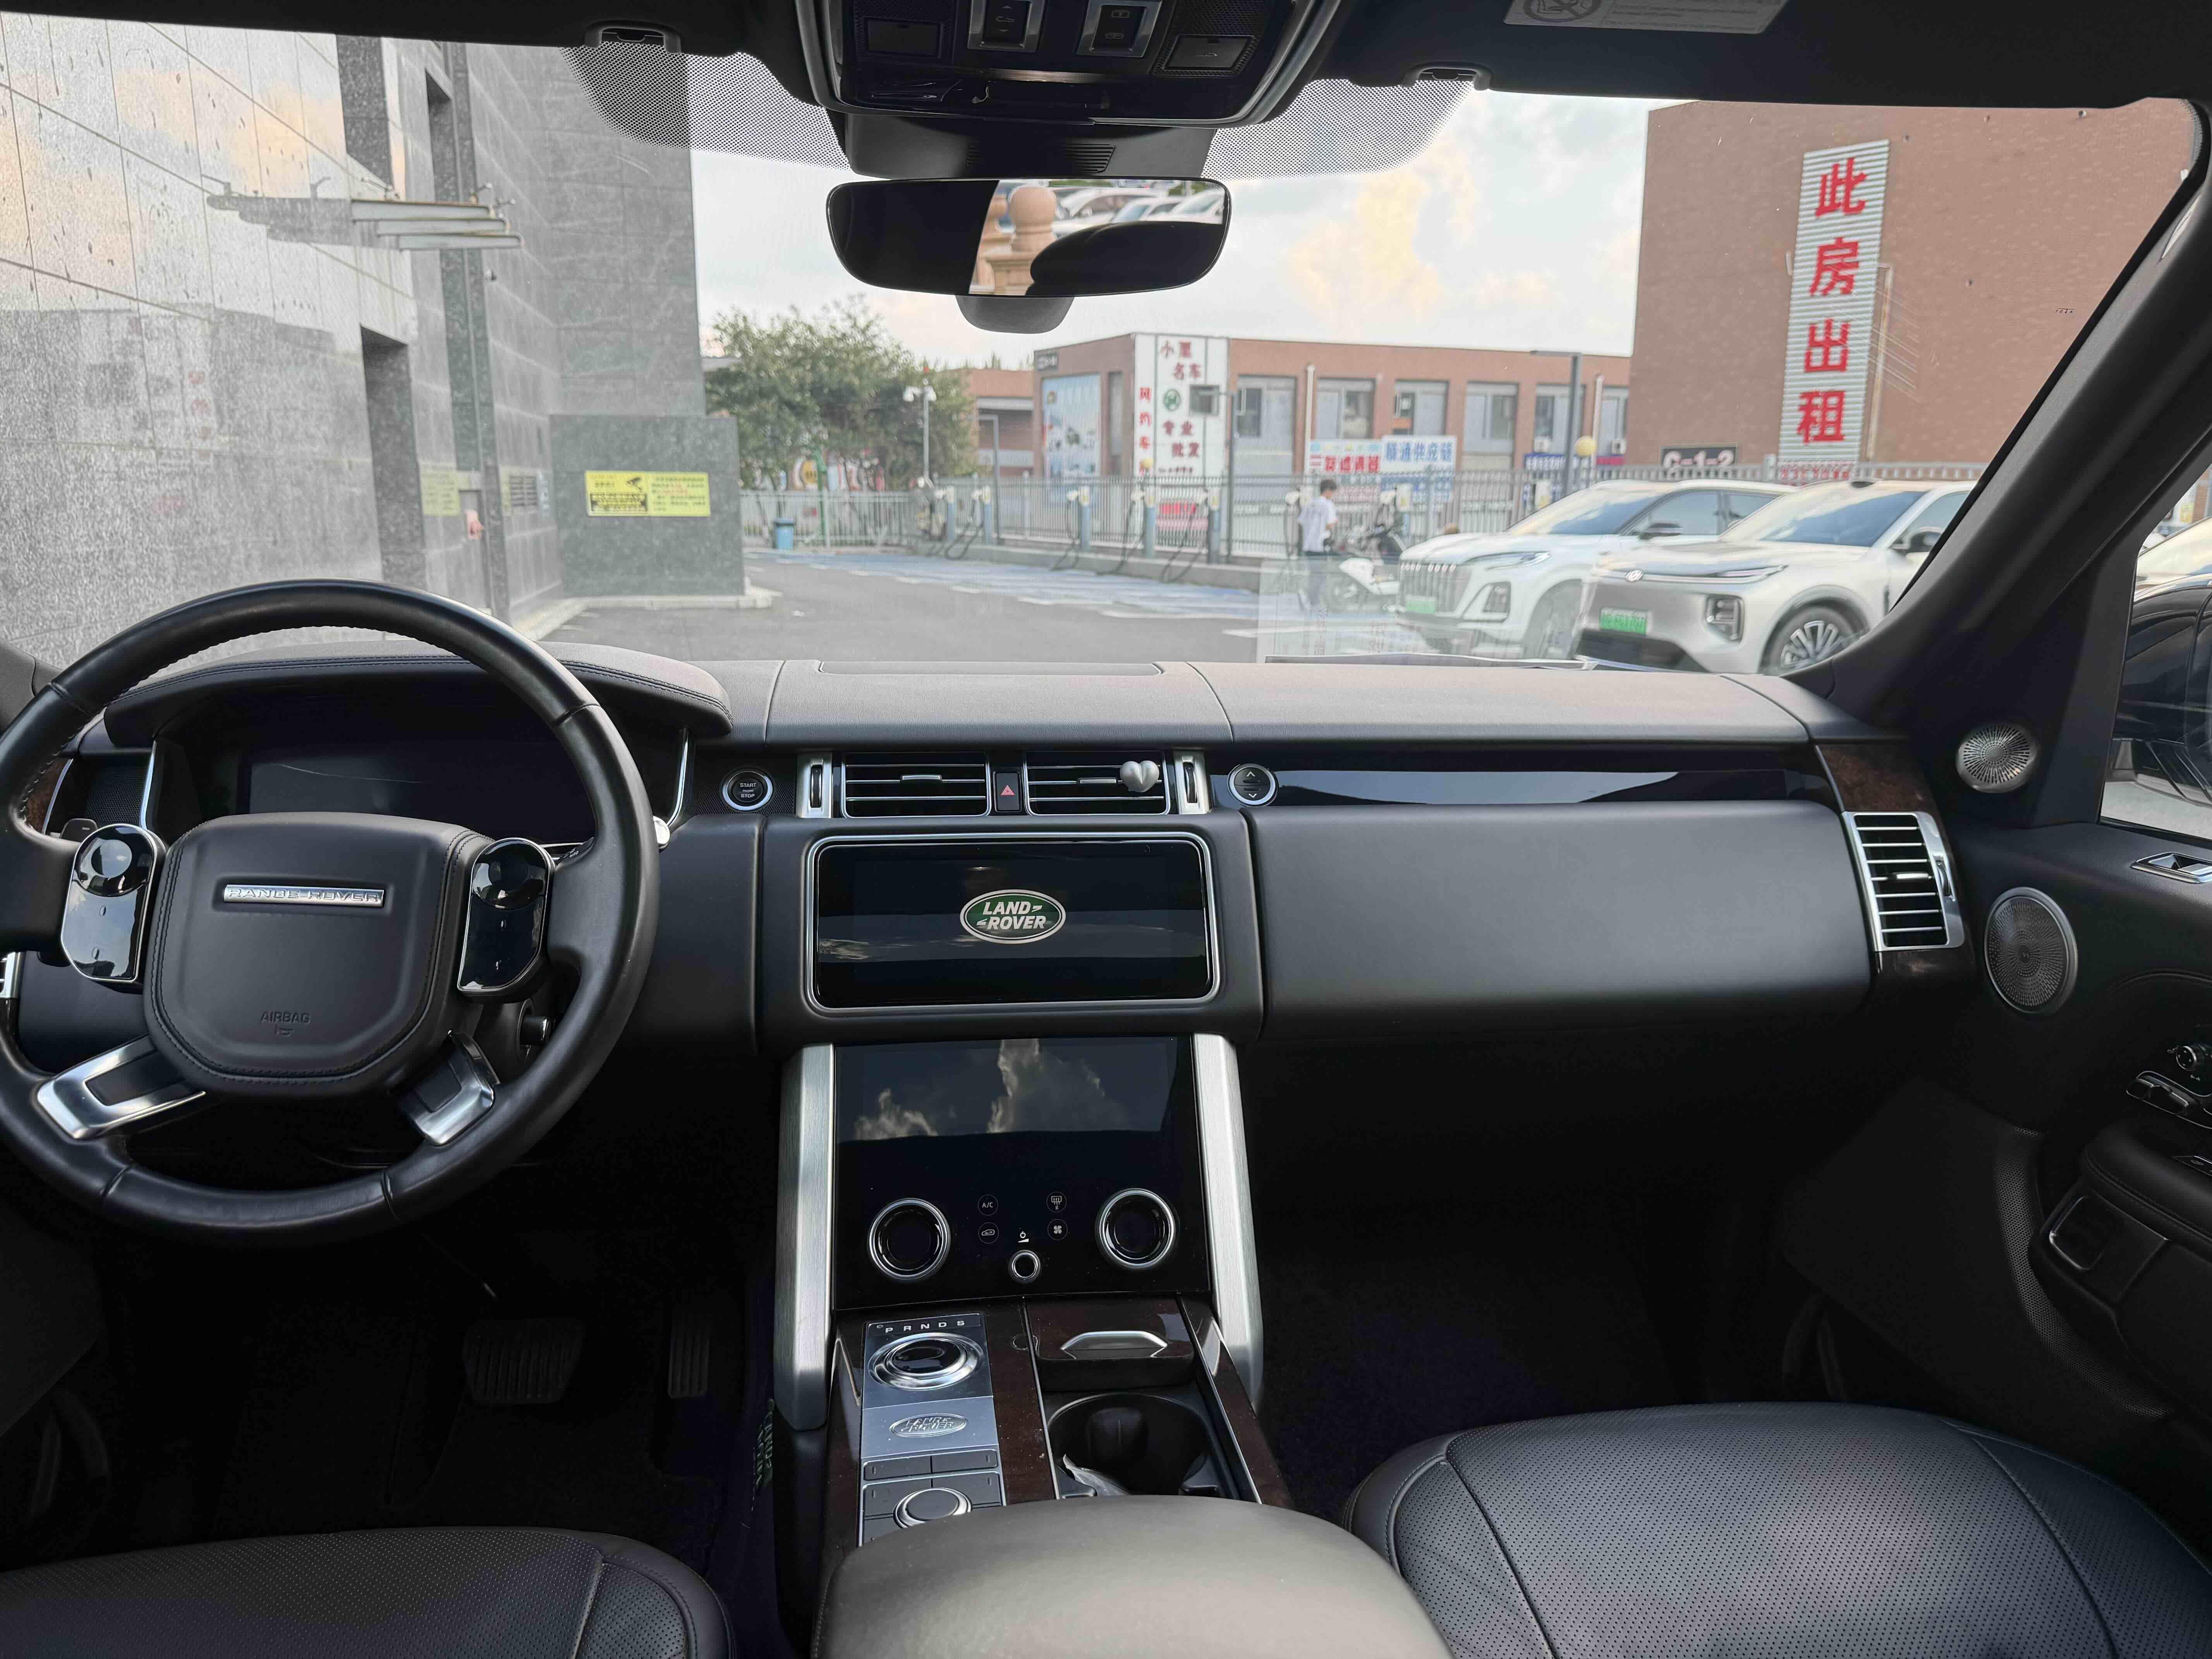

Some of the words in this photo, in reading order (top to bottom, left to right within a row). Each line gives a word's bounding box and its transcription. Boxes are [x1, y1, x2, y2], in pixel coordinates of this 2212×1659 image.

[1796, 157, 1868, 444] 此房出租
[228, 887, 301, 899] RANGE
[307, 890, 379, 902] ROVER
[982, 901, 1031, 915] LAND
[987, 915, 1046, 930] ROVER
[261, 1011, 310, 1023] AIRBAG
